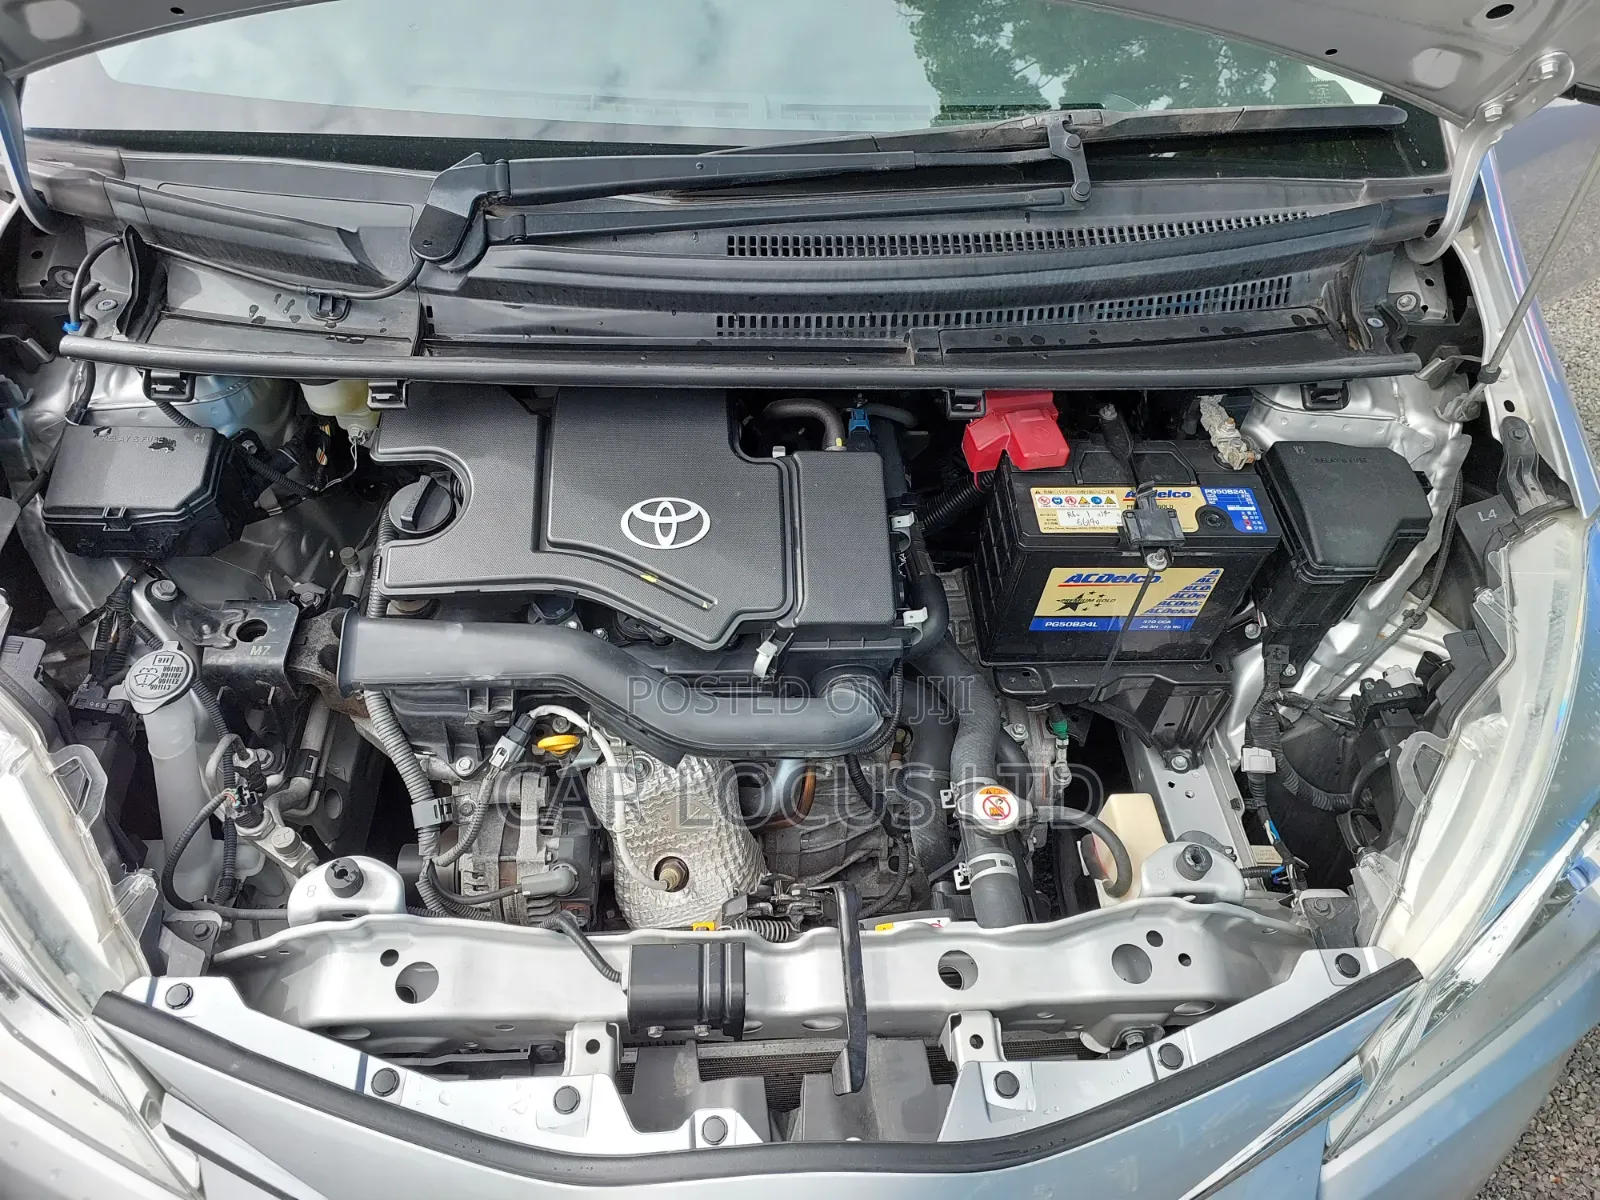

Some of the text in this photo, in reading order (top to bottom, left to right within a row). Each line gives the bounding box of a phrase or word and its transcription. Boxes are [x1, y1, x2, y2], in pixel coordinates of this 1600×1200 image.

[1125, 489, 1192, 499] Aelco
[1477, 508, 1498, 522] L4
[1063, 573, 1162, 584] ACDelco
